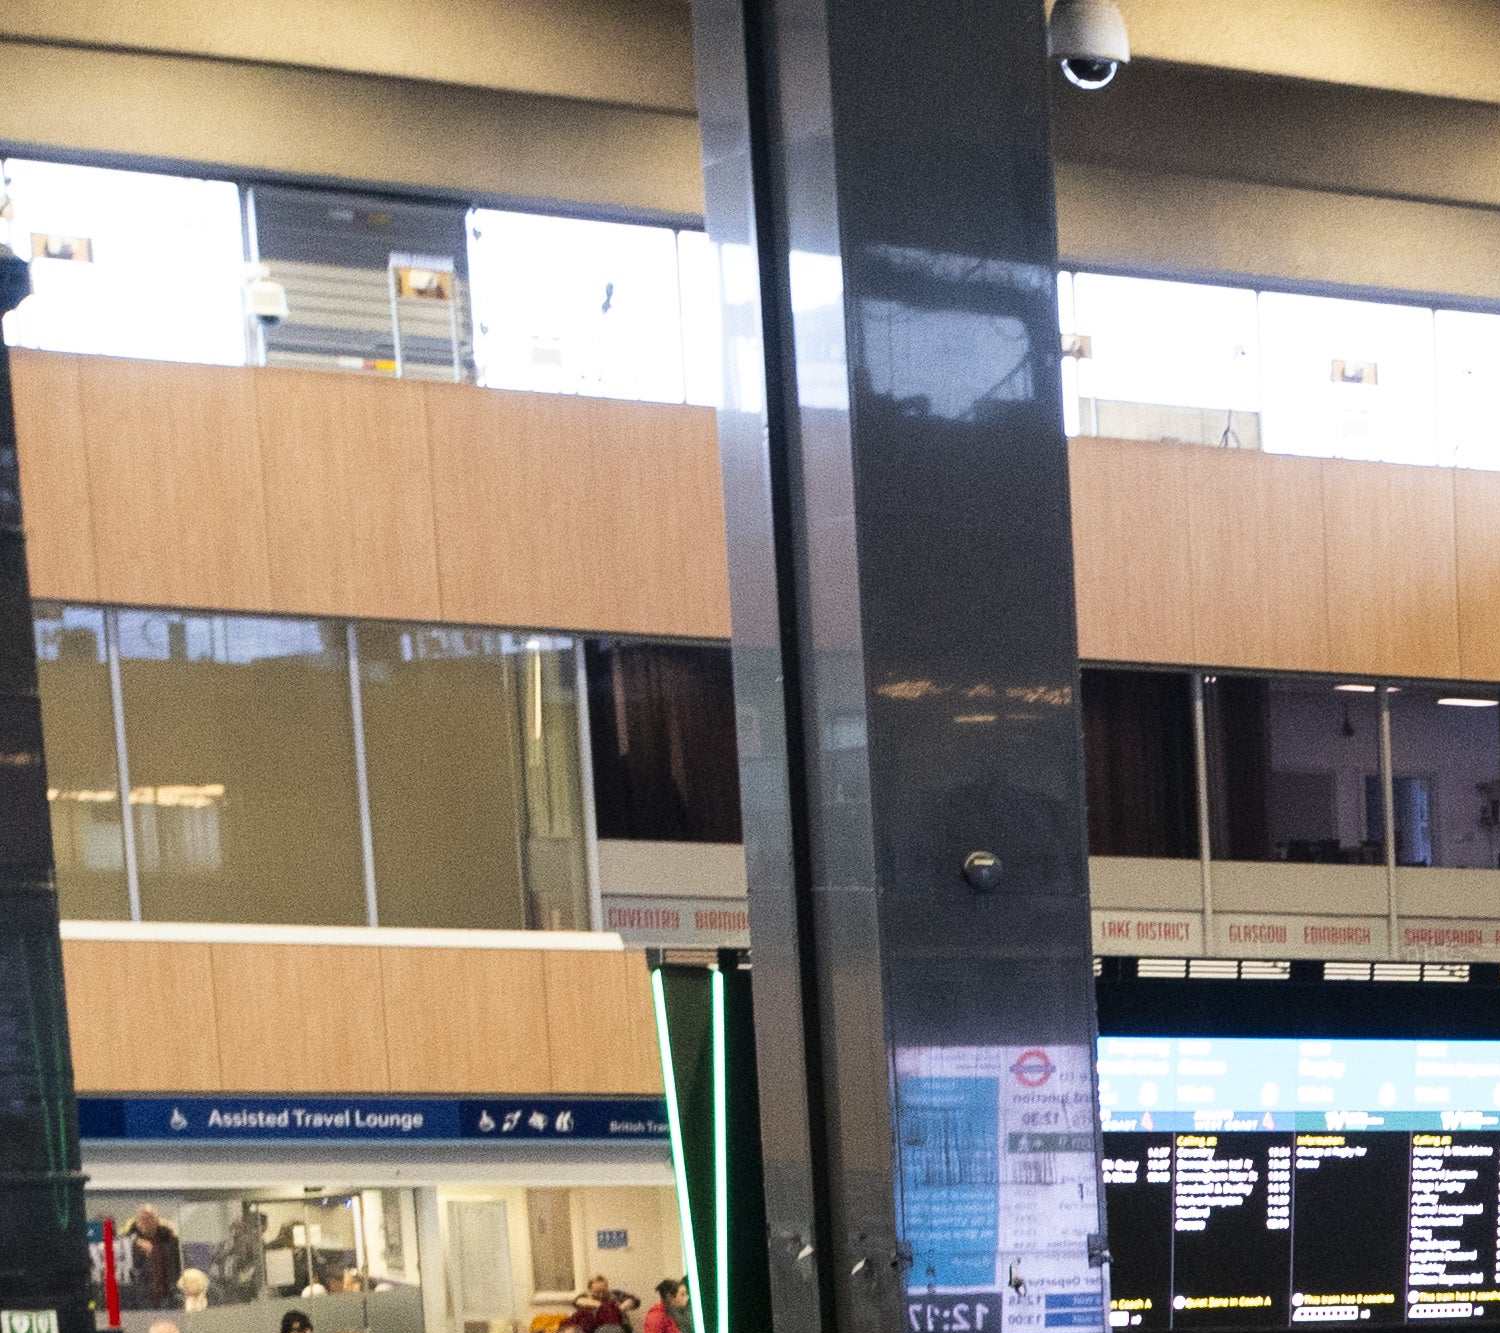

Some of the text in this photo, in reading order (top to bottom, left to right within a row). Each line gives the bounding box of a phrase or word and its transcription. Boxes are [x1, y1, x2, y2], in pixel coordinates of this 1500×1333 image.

[1101, 920, 1190, 942] LAKE DISTRICT
[1228, 924, 1371, 946] GLASGOW EDINBURGH
[1404, 927, 1483, 948] SHREWSBURY
[207, 1108, 425, 1131] Assisted Travel Lounge
[609, 1120, 646, 1134] British
